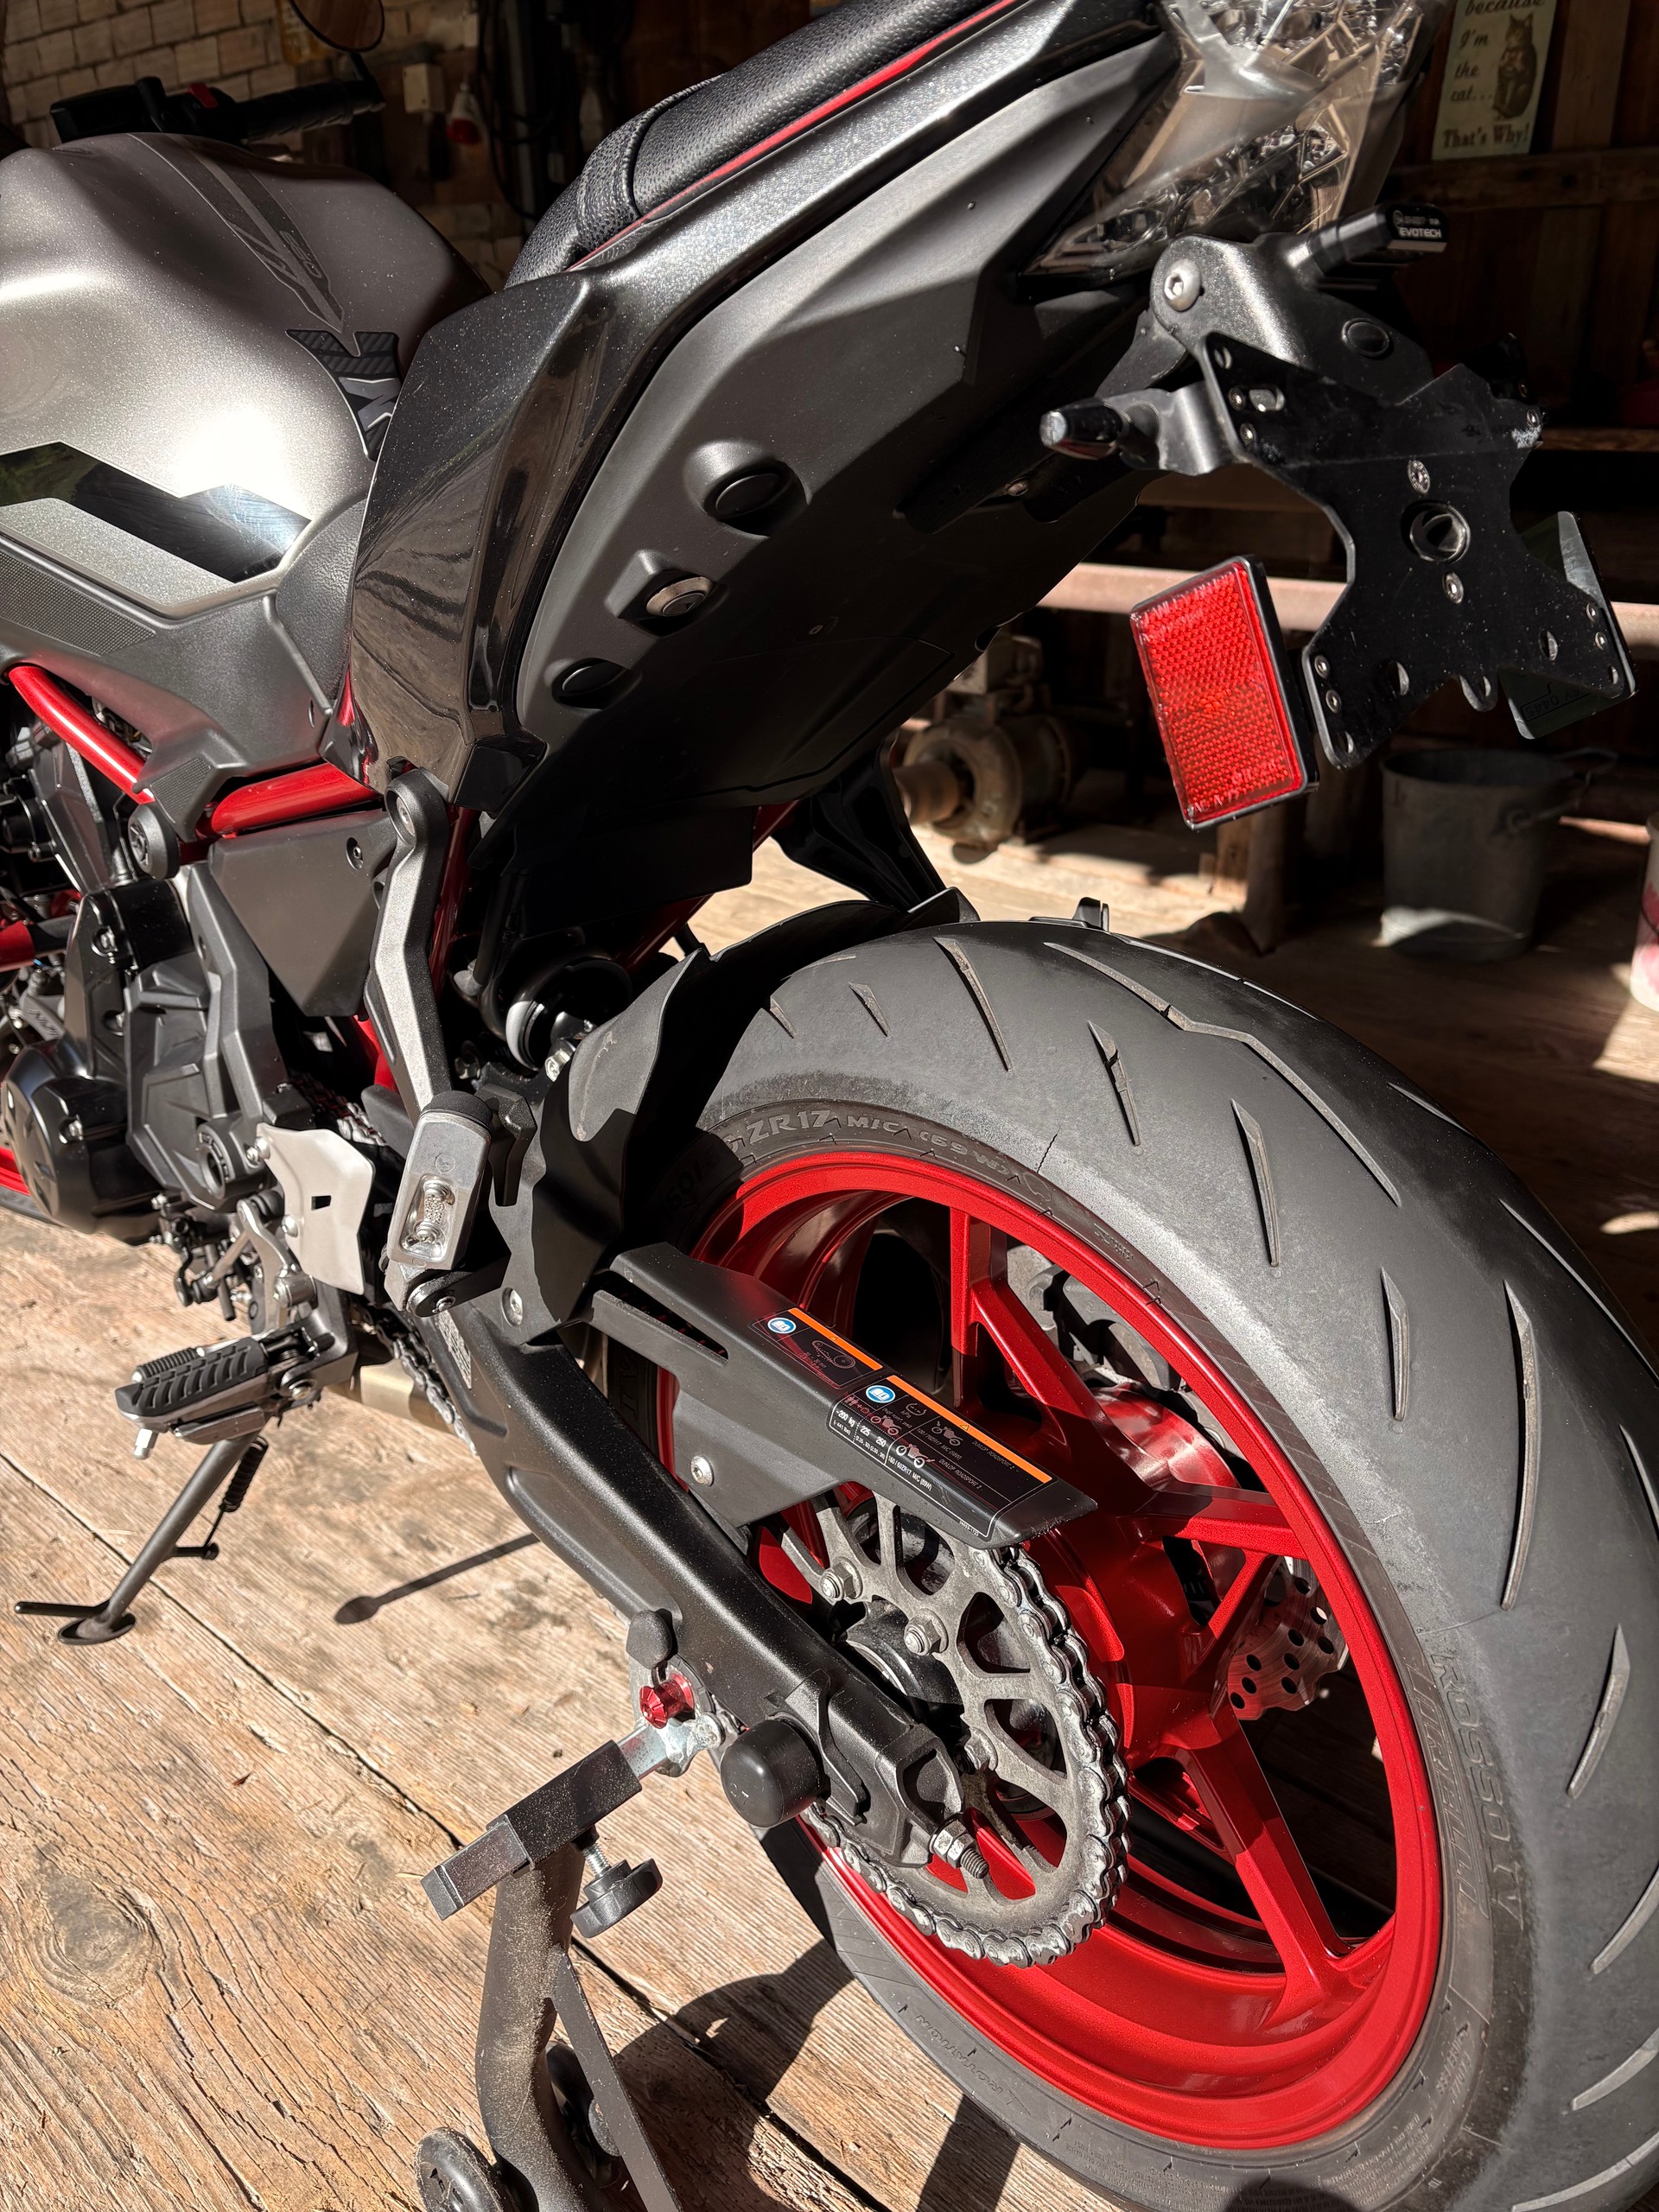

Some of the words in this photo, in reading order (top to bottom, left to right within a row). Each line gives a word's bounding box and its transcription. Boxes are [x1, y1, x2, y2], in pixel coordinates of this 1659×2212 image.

[1459, 29, 1489, 47] I'm
[1454, 60, 1479, 79] the
[1442, 125, 1486, 148] That's
[1493, 122, 1530, 149] Why!
[1399, 226, 1442, 239] EVOTECH
[745, 1109, 831, 1146] ZR17
[860, 1426, 871, 1436] 225
[876, 1437, 887, 1446] 250
[1431, 1653, 1512, 1842] ROSSO
[915, 2014, 1003, 2095] ROTATION
